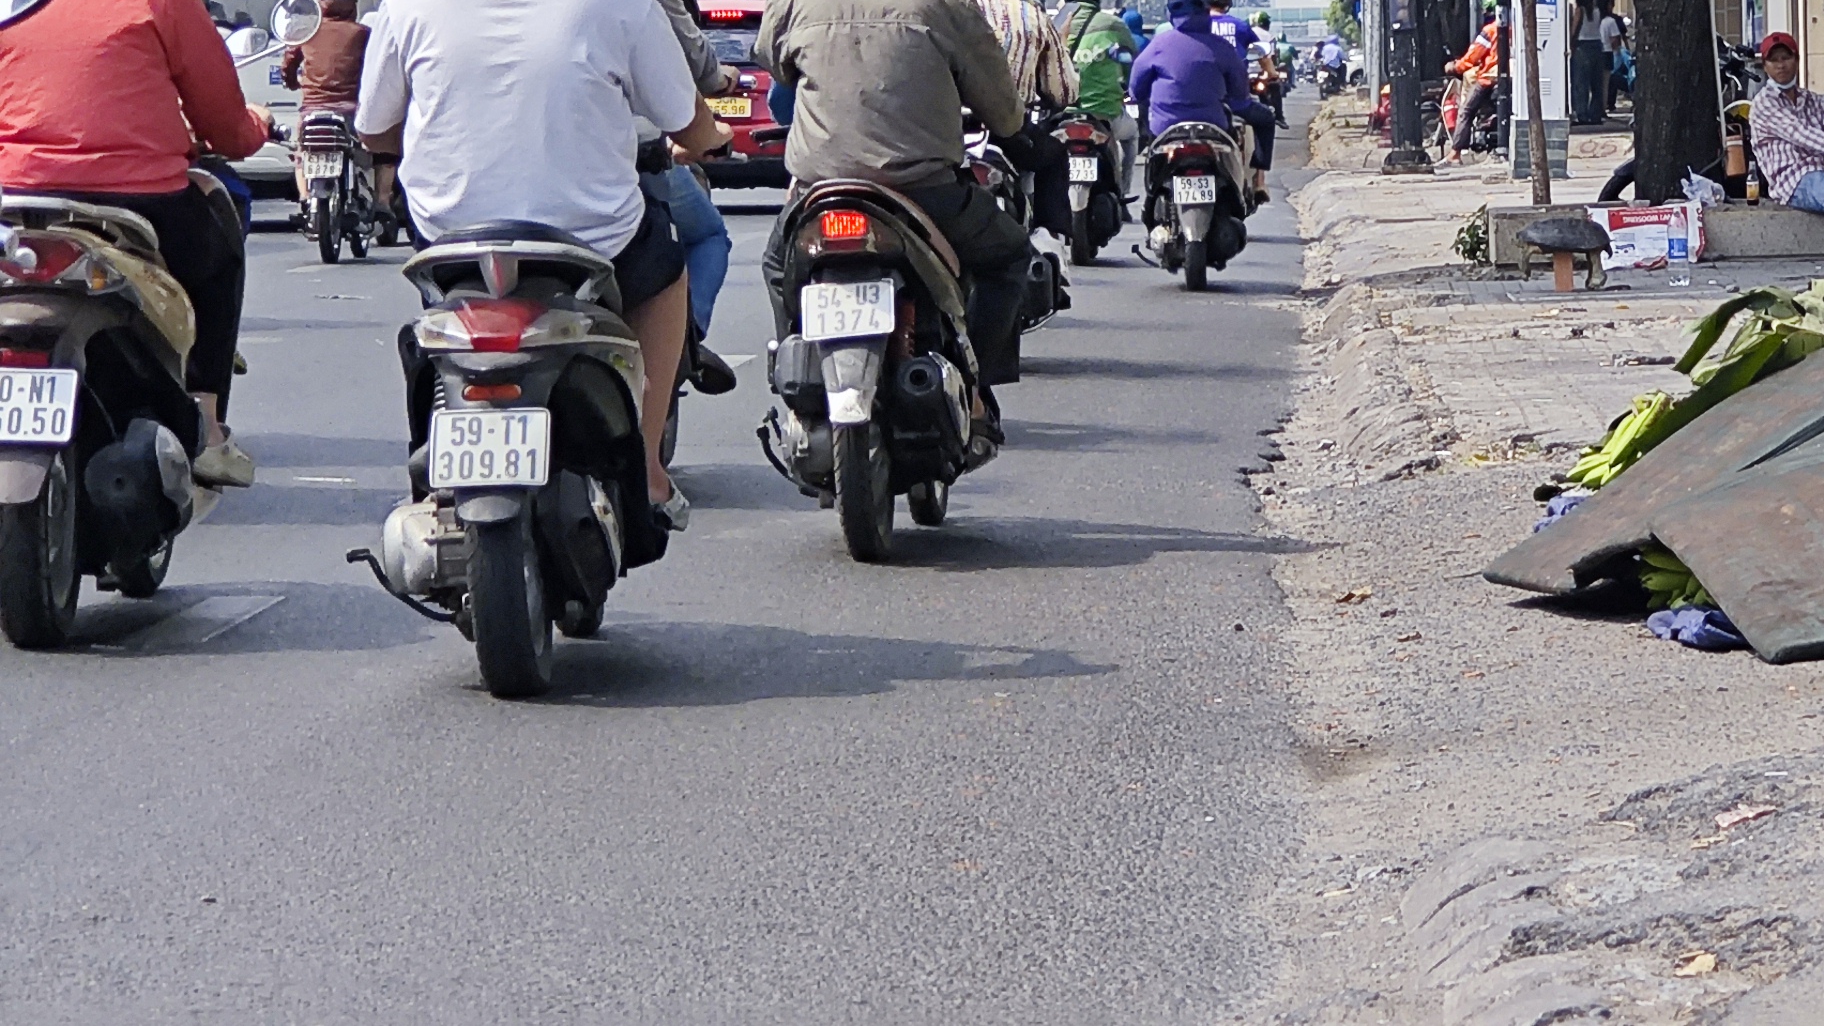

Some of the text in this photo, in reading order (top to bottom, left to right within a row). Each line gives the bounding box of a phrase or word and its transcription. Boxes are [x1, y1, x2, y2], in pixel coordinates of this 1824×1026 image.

[1180, 177, 1209, 190] 59-S3
[817, 284, 881, 309] 54-U3
[817, 308, 881, 334] 1374
[450, 414, 528, 447] 59-T1
[438, 448, 538, 481] 309.81
